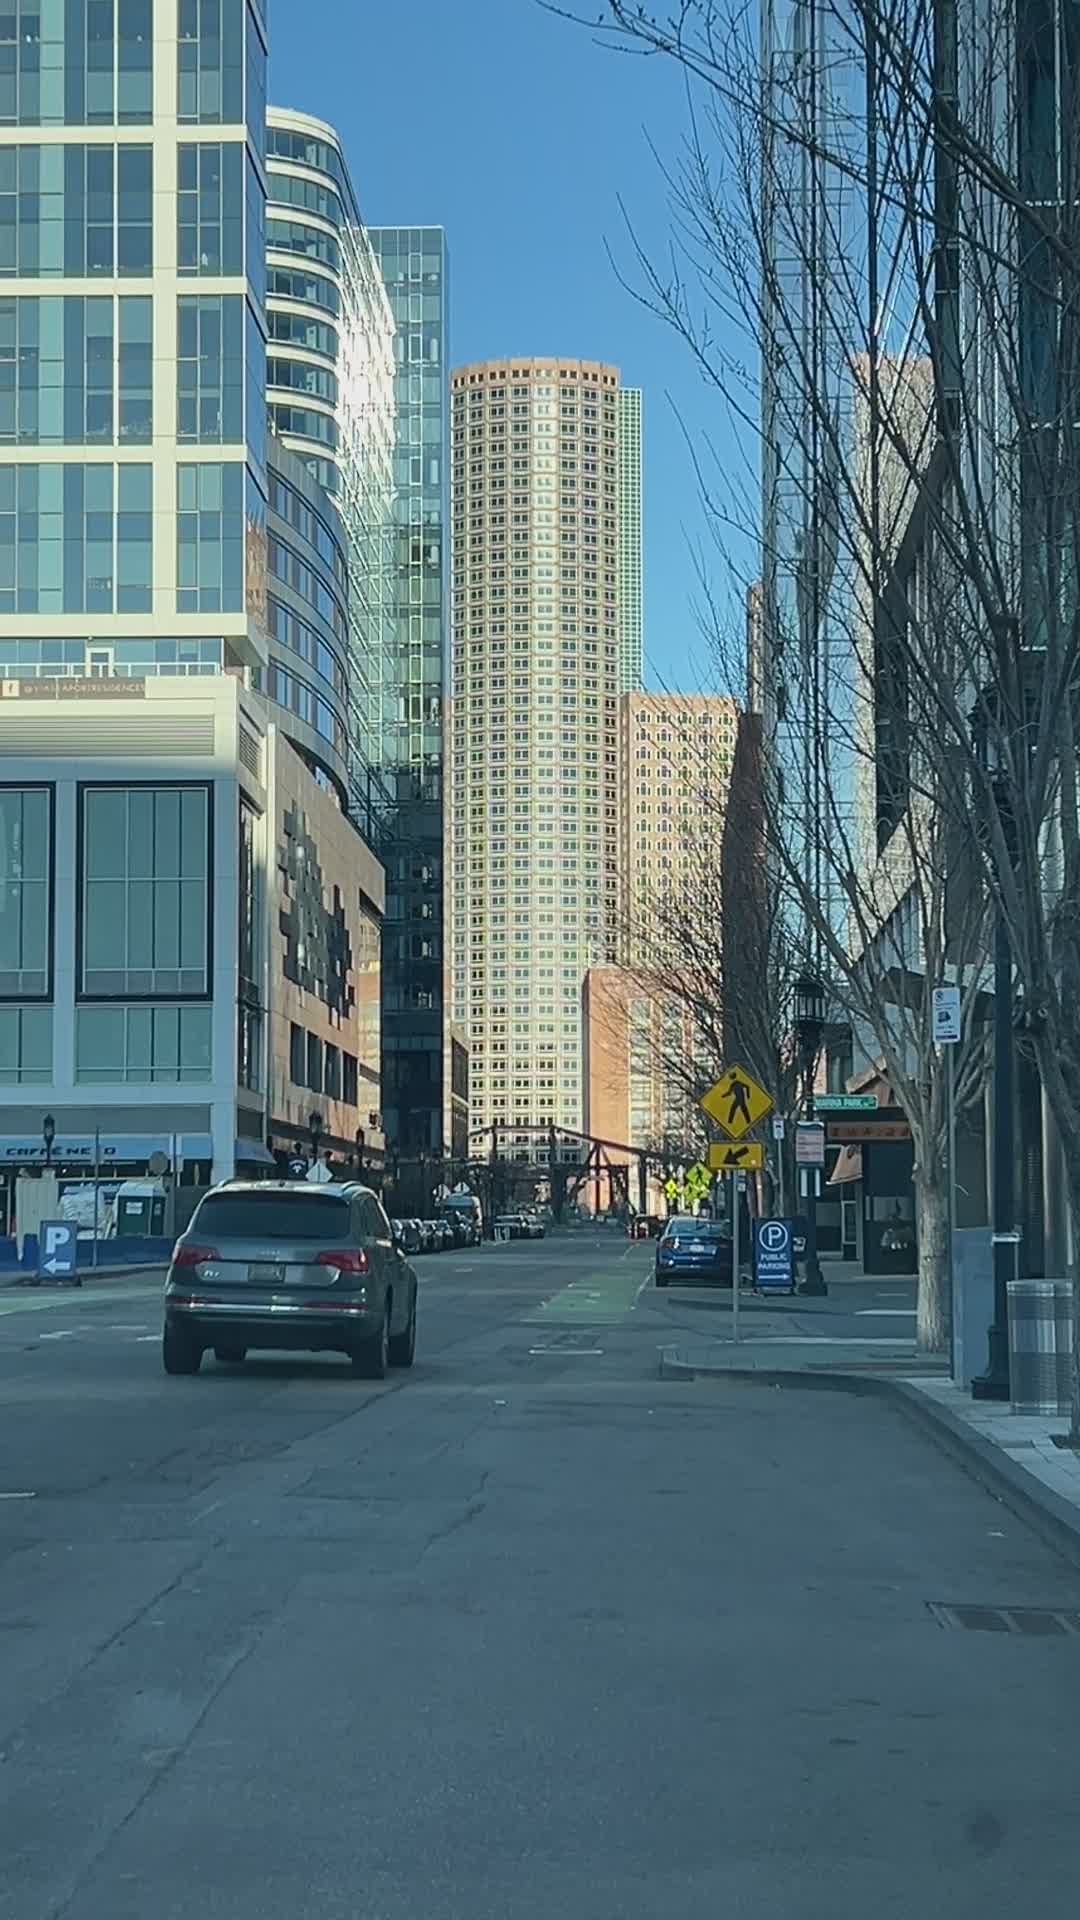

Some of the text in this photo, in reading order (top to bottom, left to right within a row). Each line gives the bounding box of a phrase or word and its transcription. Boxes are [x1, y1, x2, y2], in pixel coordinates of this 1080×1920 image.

[66, 1147, 116, 1155] NEO
[767, 1226, 782, 1246] P
[46, 1227, 70, 1254] P
[761, 1253, 787, 1261] PUBLIC
[757, 1262, 790, 1270] PARKING
